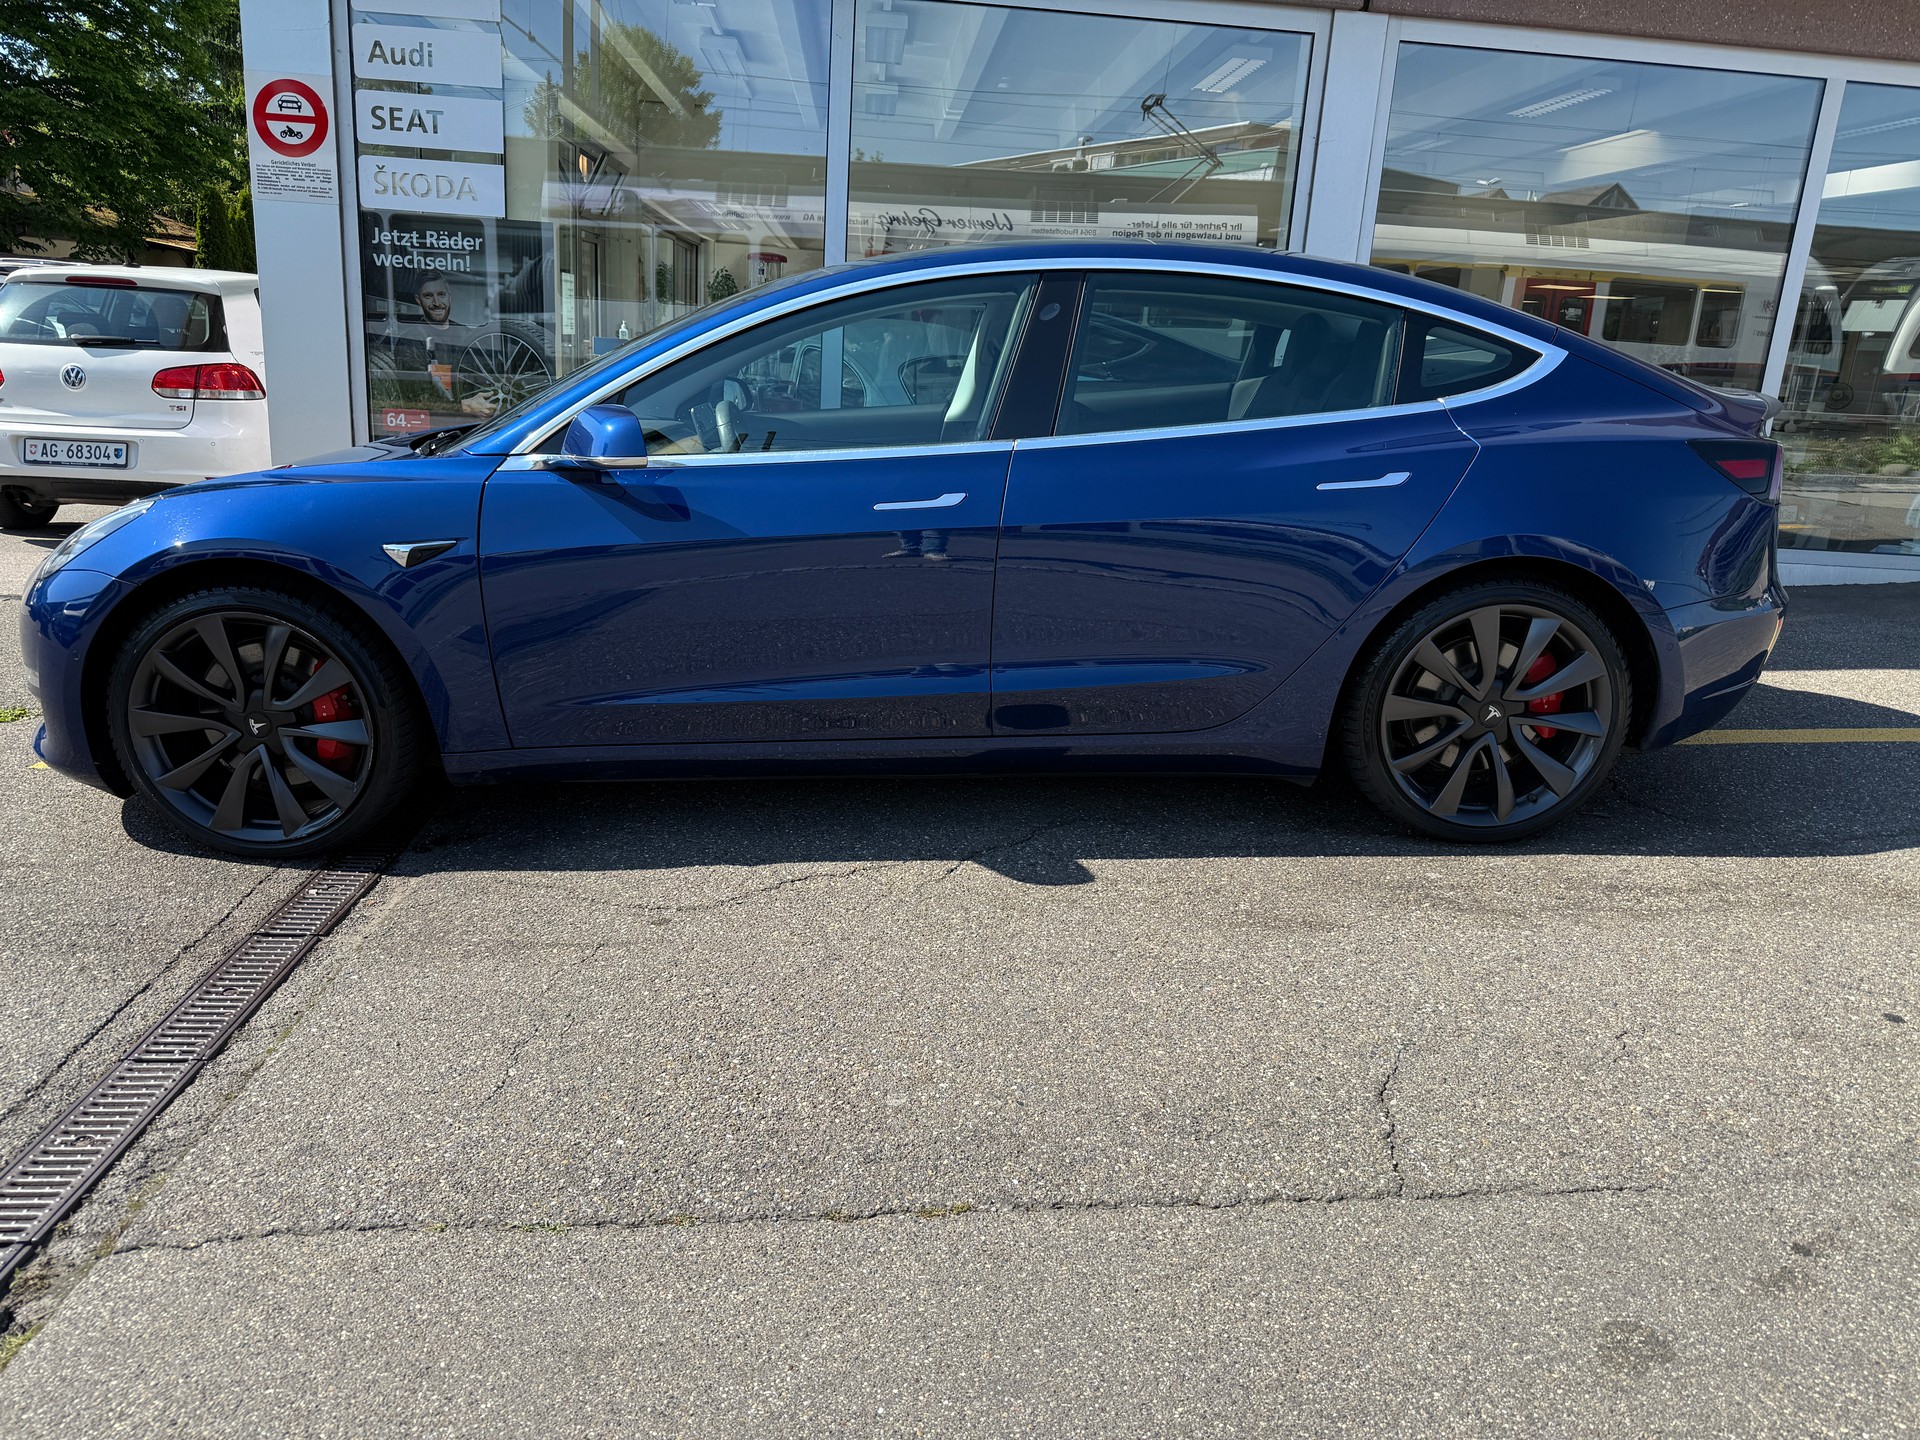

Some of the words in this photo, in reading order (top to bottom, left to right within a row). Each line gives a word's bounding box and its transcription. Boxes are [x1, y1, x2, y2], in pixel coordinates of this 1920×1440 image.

[367, 40, 433, 68] Audi
[370, 105, 444, 134] SEAT
[373, 164, 479, 201] ŠKODA
[371, 227, 420, 247] Jetzt
[425, 230, 483, 251] Räder
[372, 250, 471, 272] wechseln!
